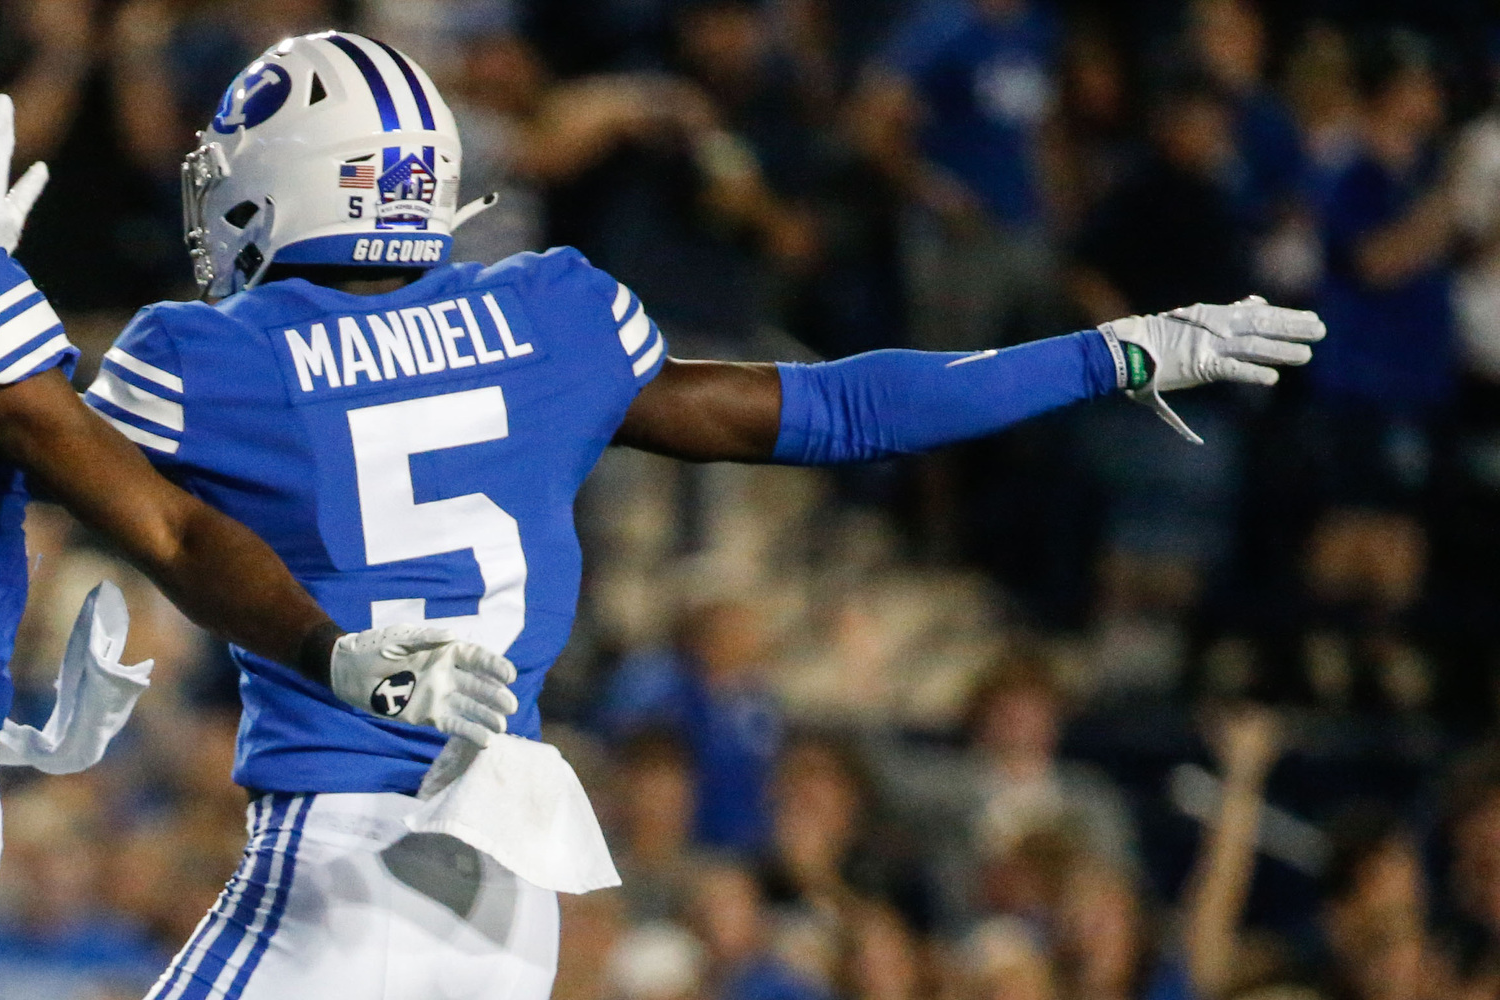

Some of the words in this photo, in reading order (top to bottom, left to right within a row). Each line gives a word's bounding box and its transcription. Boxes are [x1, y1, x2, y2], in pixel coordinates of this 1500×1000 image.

[348, 196, 363, 218] 5
[352, 239, 384, 261] GO
[386, 240, 444, 262] COUGS
[284, 291, 534, 392] MANDELL
[347, 386, 528, 656] 5
